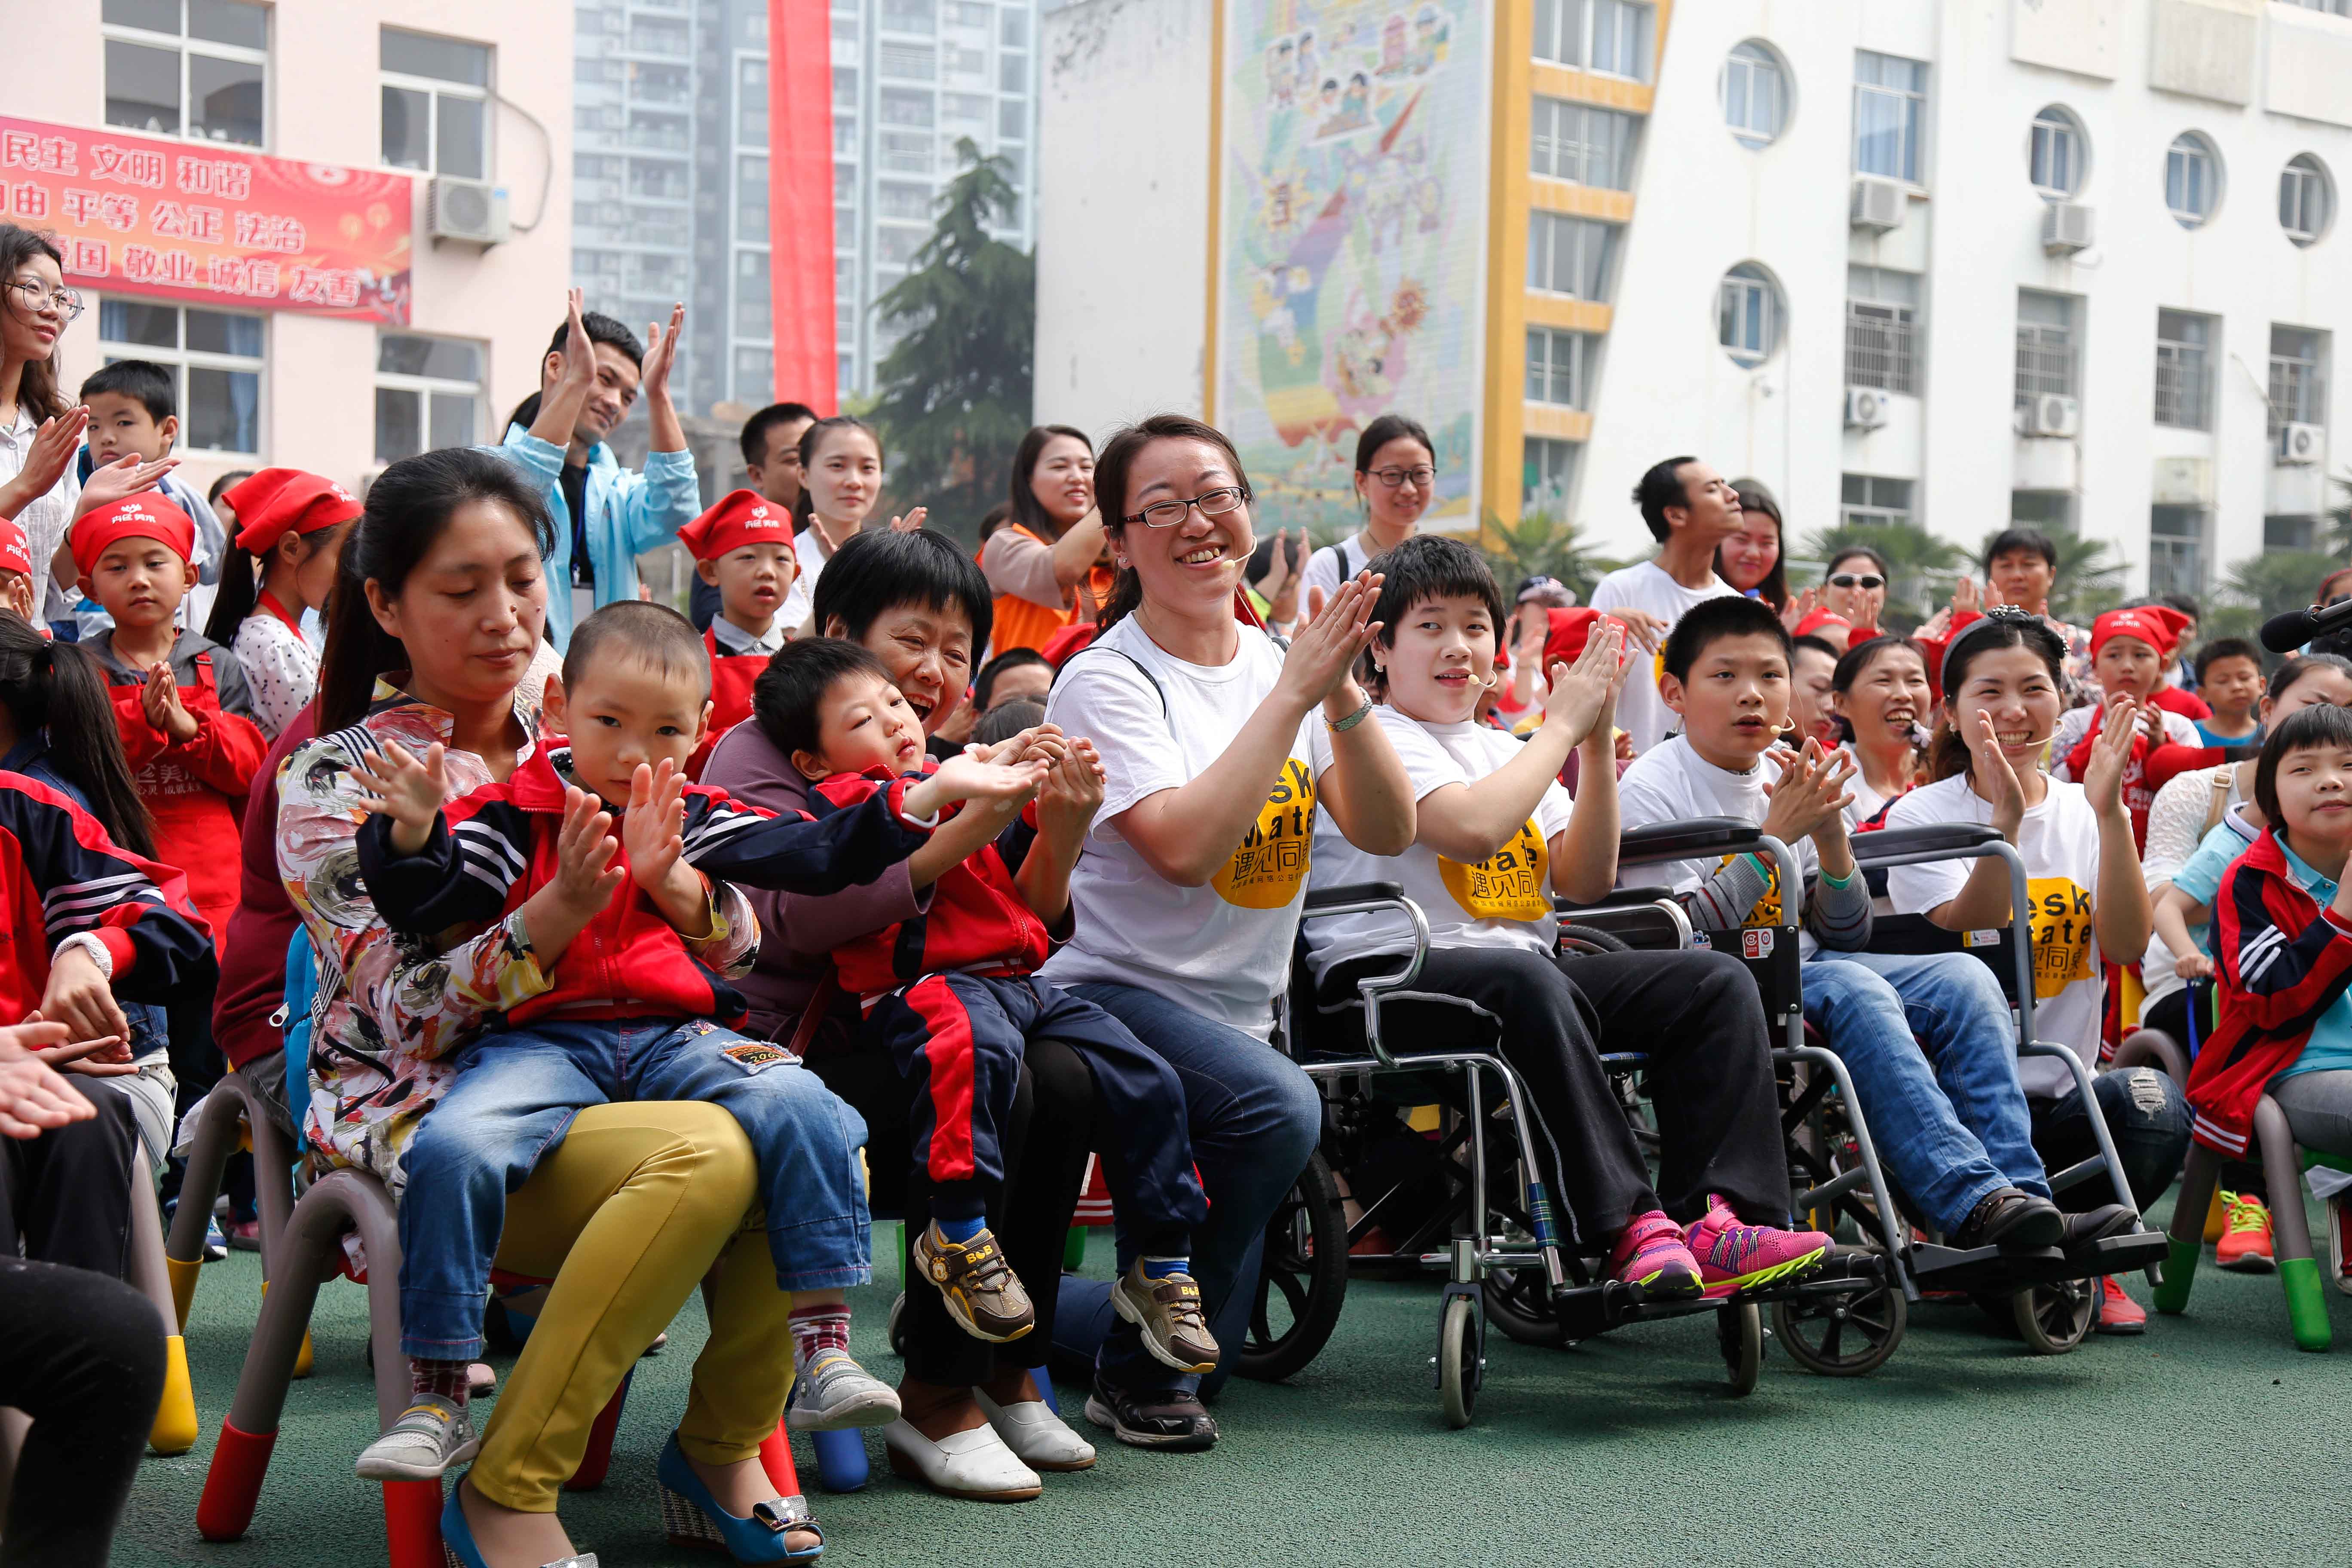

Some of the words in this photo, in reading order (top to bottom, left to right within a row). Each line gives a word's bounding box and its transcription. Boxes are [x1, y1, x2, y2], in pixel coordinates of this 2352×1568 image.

[3, 130, 79, 177] 民主
[90, 144, 166, 188] 文明
[176, 156, 252, 200] 和谐
[62, 187, 138, 233] 平等
[150, 200, 224, 245] 公正
[234, 210, 306, 254] 法治
[122, 242, 196, 288] 敬业
[205, 257, 280, 299] 诚信
